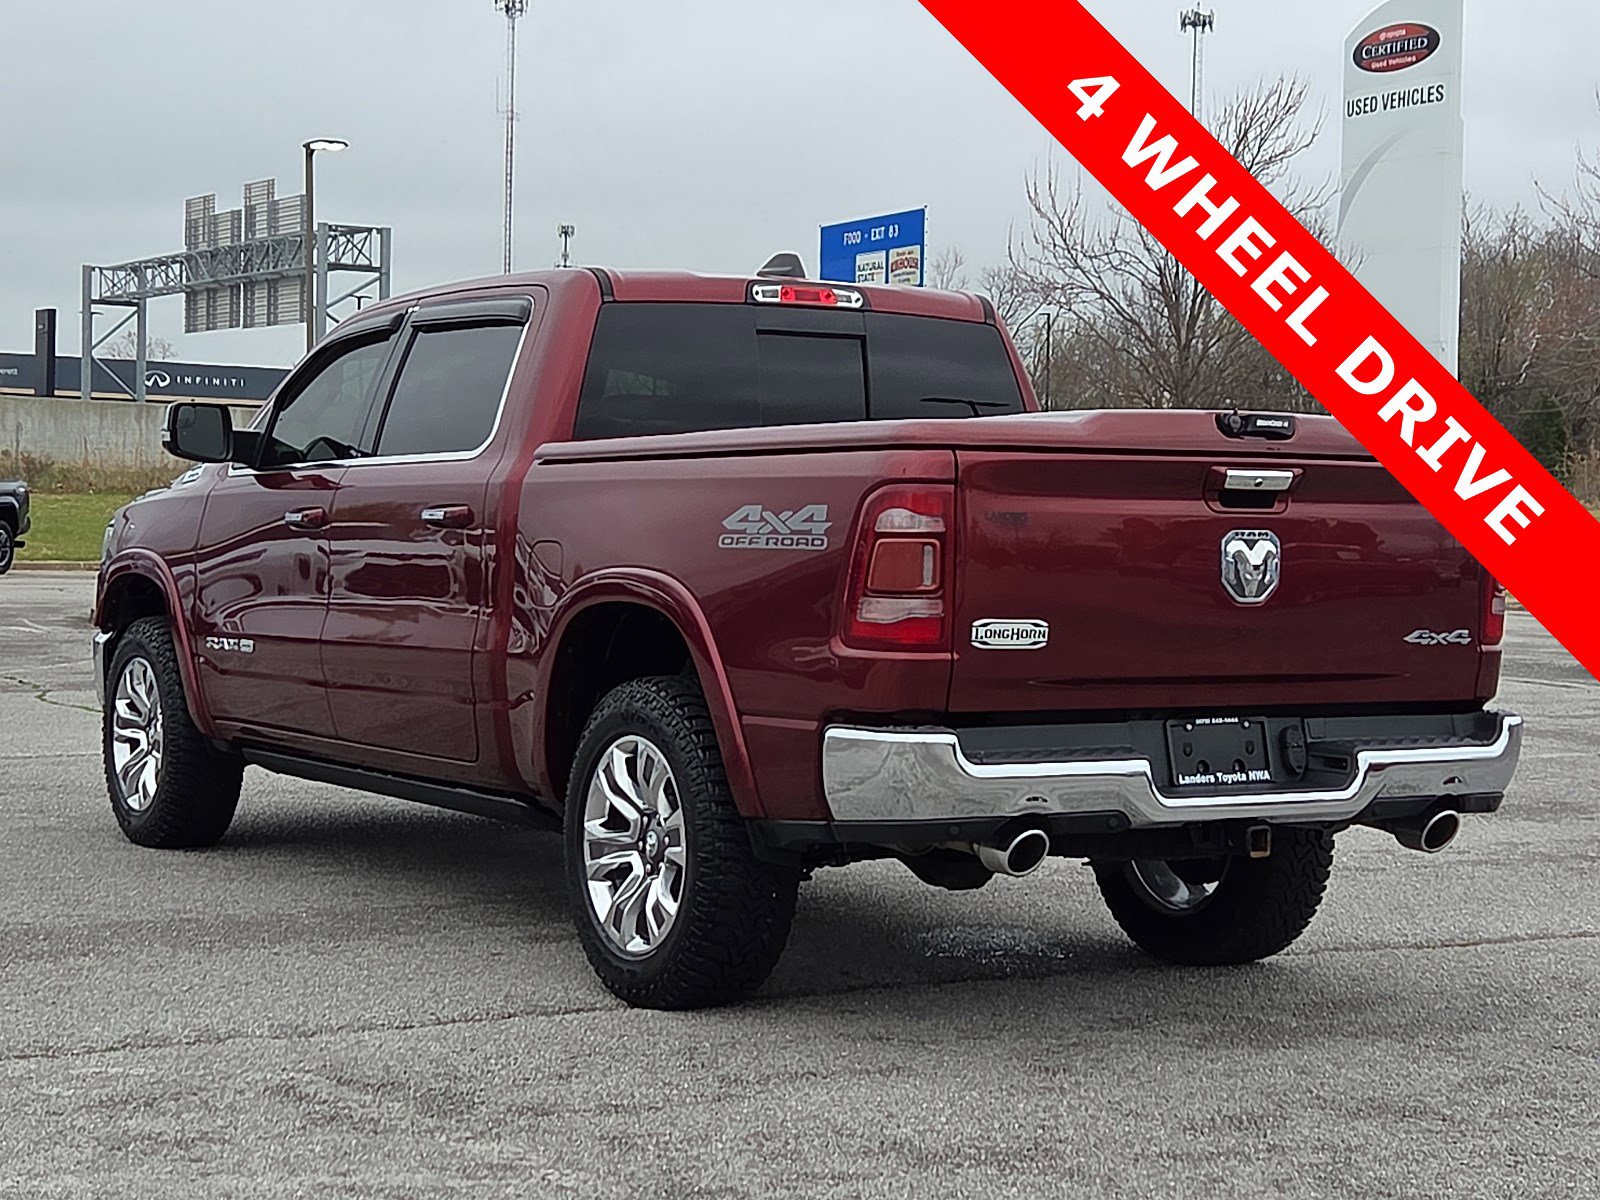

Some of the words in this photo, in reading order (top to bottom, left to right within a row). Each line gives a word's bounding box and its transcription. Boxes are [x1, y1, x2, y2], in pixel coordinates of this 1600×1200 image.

[1362, 38, 1428, 59] CERTIFIED
[1347, 96, 1378, 117] USED
[1381, 85, 1444, 110] VEHICLES
[843, 231, 861, 245] FOOD
[176, 376, 245, 387] INFINITI
[720, 536, 762, 546] OFF
[765, 537, 825, 547] ROAD
[1179, 773, 1216, 785] Landers
[1216, 771, 1247, 784] Toyota
[1248, 769, 1271, 781] NWA
